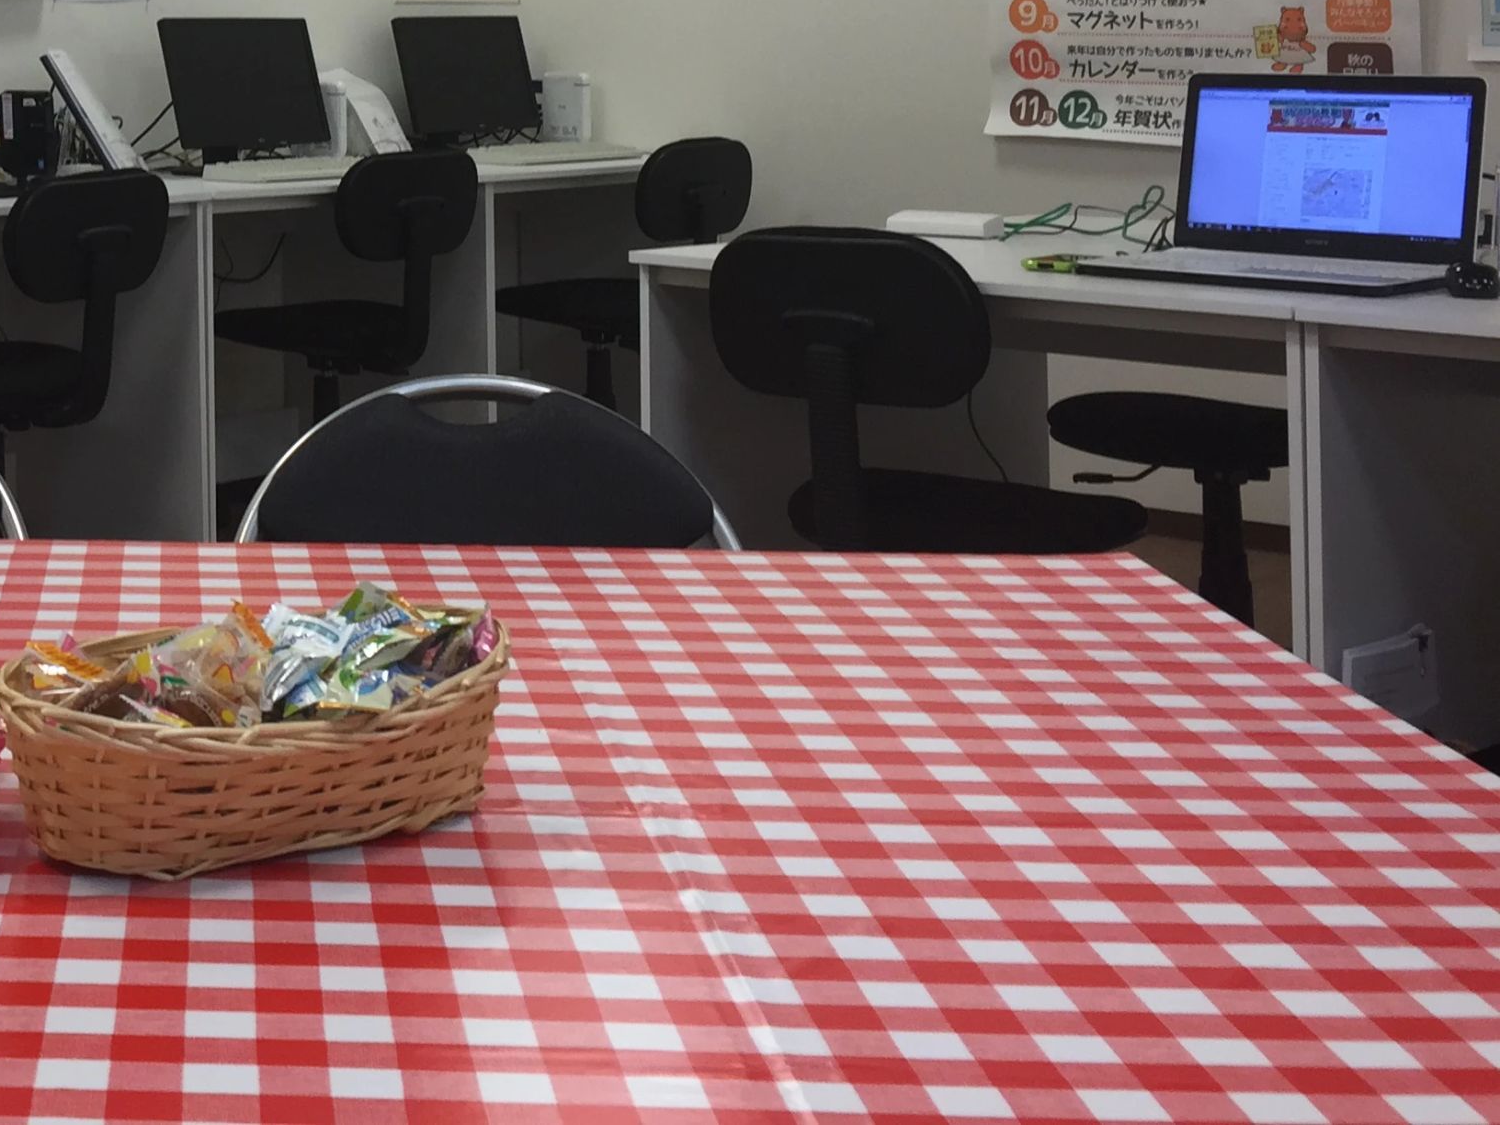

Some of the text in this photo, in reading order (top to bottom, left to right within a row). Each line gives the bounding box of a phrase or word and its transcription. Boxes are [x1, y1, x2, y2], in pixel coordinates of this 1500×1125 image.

[1018, 0, 1055, 25] 9月
[1067, 10, 1199, 29] マグネットを作ろう!
[1014, 47, 1056, 75] 10月
[1067, 45, 1252, 59] 来年は自分で作ったものを飾りませんか?
[1015, 95, 1104, 125] 11月 12月
